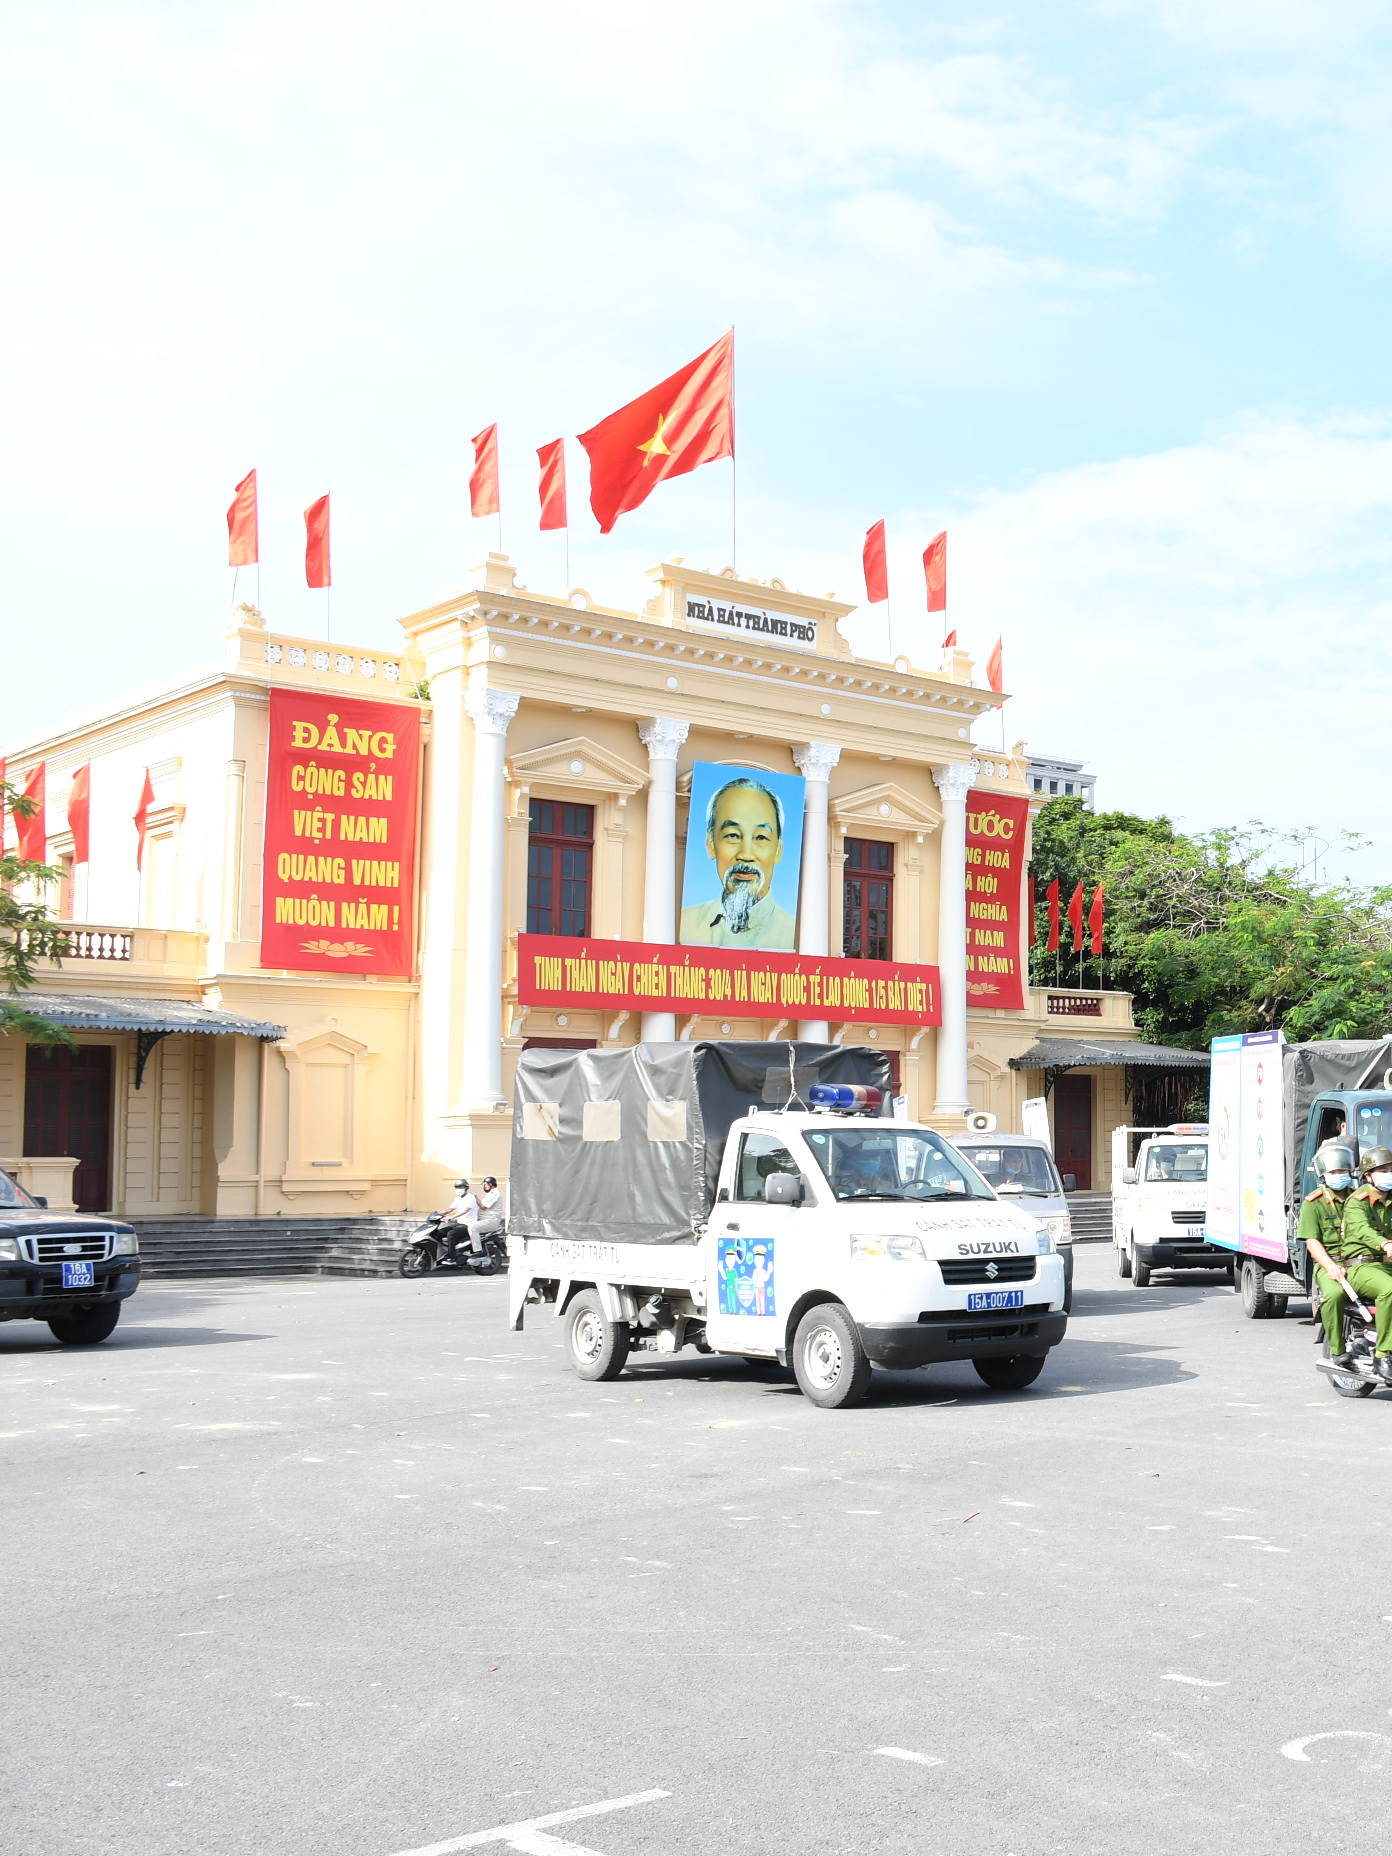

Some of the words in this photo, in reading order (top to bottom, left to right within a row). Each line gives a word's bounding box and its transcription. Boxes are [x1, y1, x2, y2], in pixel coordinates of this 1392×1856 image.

[687, 600, 715, 622] NHÀ
[716, 606, 744, 628] HÁT
[744, 612, 789, 637] THÀNH
[789, 622, 817, 642] PHỐ
[291, 714, 397, 759] ĐẢNG
[291, 761, 345, 799] CỘNG
[351, 763, 393, 801] SẢN
[293, 806, 335, 845] VIỆT
[340, 815, 388, 844] NAM
[965, 810, 1015, 839] ƯỚC
[277, 852, 346, 885] QUANG
[351, 859, 400, 888] VINH
[965, 847, 982, 865] NG
[985, 849, 1010, 869] HOÀ
[965, 871, 973, 891] Ã
[976, 872, 998, 897] HỘI
[275, 894, 336, 928] MUÔN
[970, 901, 1008, 922] NGHĨA
[975, 930, 1005, 948] NAM
[534, 956, 562, 991] TINH
[565, 947, 596, 993] THẦN
[599, 954, 631, 995] NGÀY
[633, 953, 667, 997] CHIẾN
[670, 954, 706, 1000] THẮNG
[708, 968, 732, 1001] 30/4
[734, 963, 749, 1002] VÀ
[750, 965, 779, 1004] NGÀY
[780, 963, 808, 1007] QUỐC
[809, 965, 822, 1006] TẾ
[823, 976, 841, 1007] LAO
[843, 971, 870, 1014] ĐỘNG
[871, 979, 887, 1010] 1/5
[888, 971, 906, 1011] BẤT
[907, 976, 927, 1019] DIỆT
[957, 1241, 1020, 1256] SUZUKI
[68, 1274, 91, 1286] 1032
[69, 1263, 88, 1275] 16A
[969, 1291, 1022, 1310] 15A-007.11
